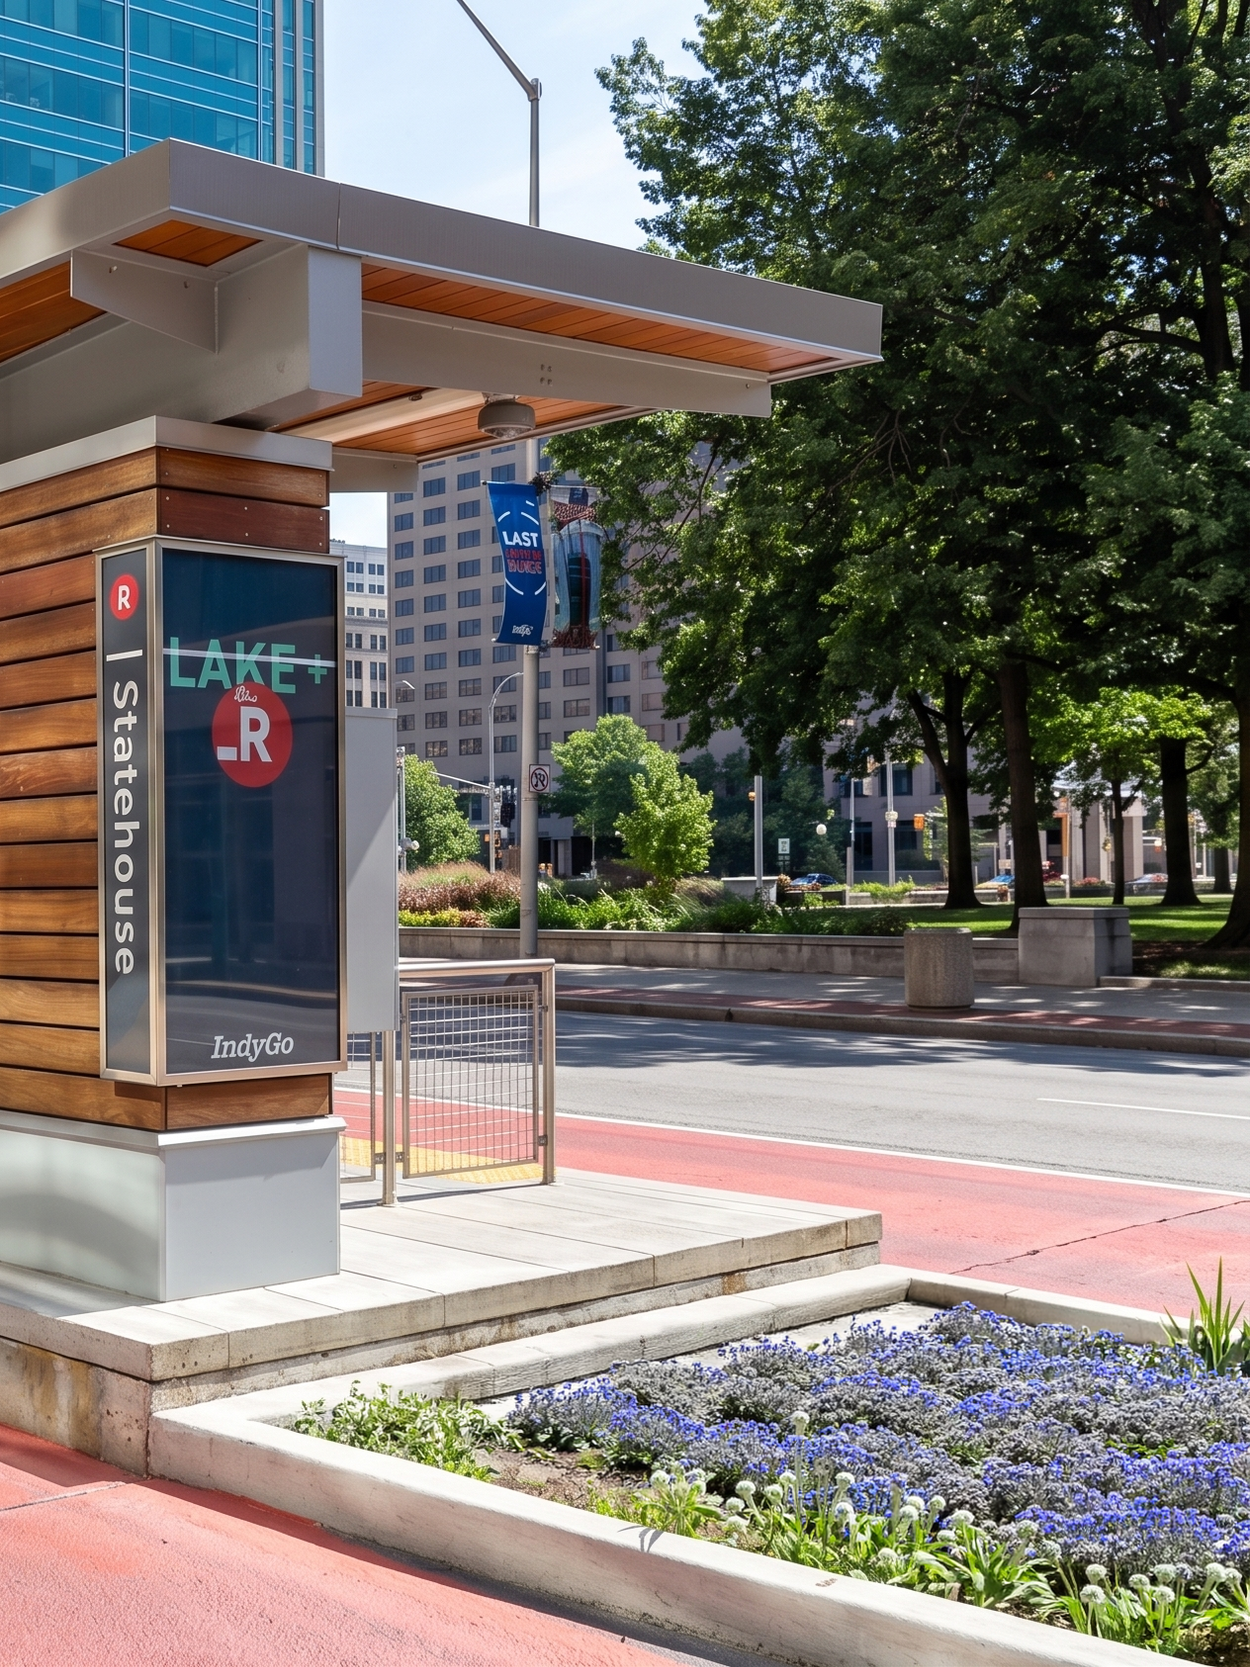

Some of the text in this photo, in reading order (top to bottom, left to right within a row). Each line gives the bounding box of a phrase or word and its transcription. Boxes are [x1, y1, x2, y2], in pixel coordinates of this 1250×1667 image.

[502, 531, 538, 547] LAST
[118, 585, 131, 611] R
[113, 680, 140, 975] Statehouse
[211, 1032, 294, 1063] IndyGo
